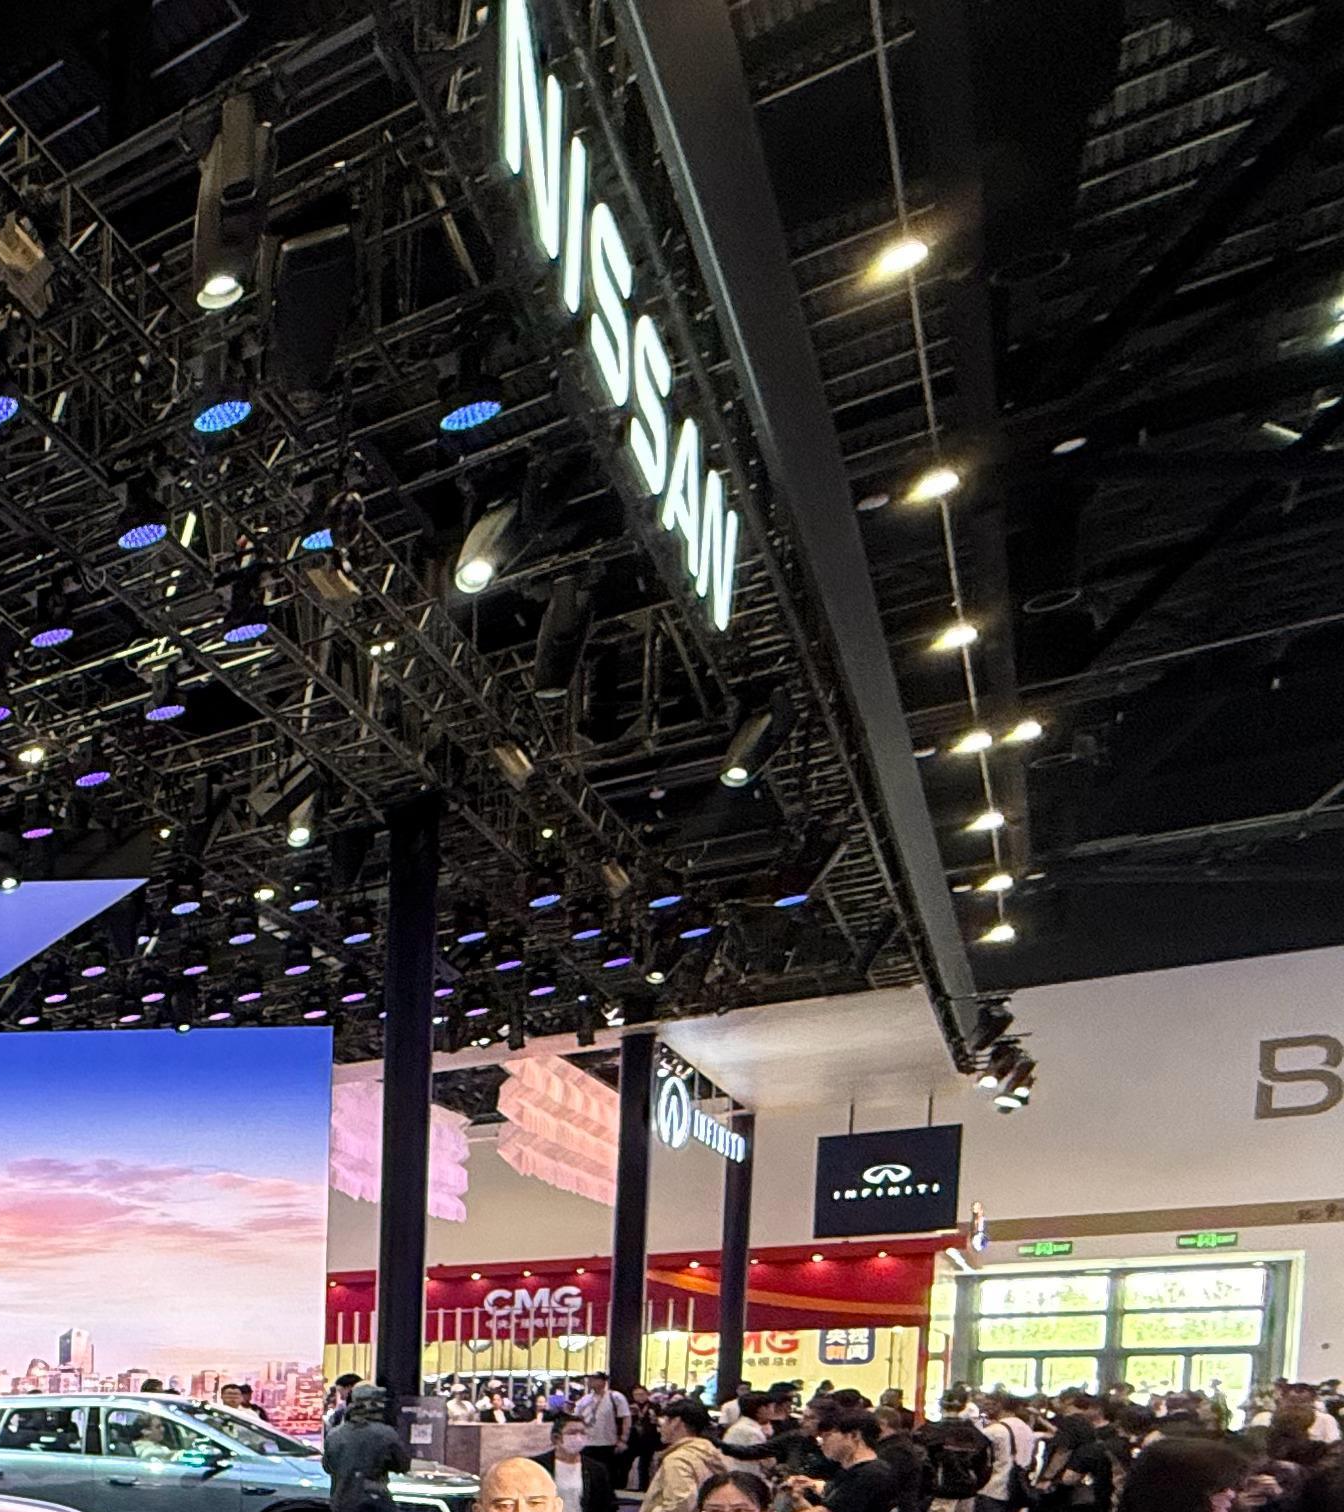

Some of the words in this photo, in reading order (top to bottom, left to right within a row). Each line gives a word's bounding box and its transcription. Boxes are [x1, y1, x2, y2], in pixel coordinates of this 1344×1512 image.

[502, 0, 739, 631] NISSAN
[833, 1183, 940, 1200] INFINITI
[484, 1286, 582, 1315] CMG
